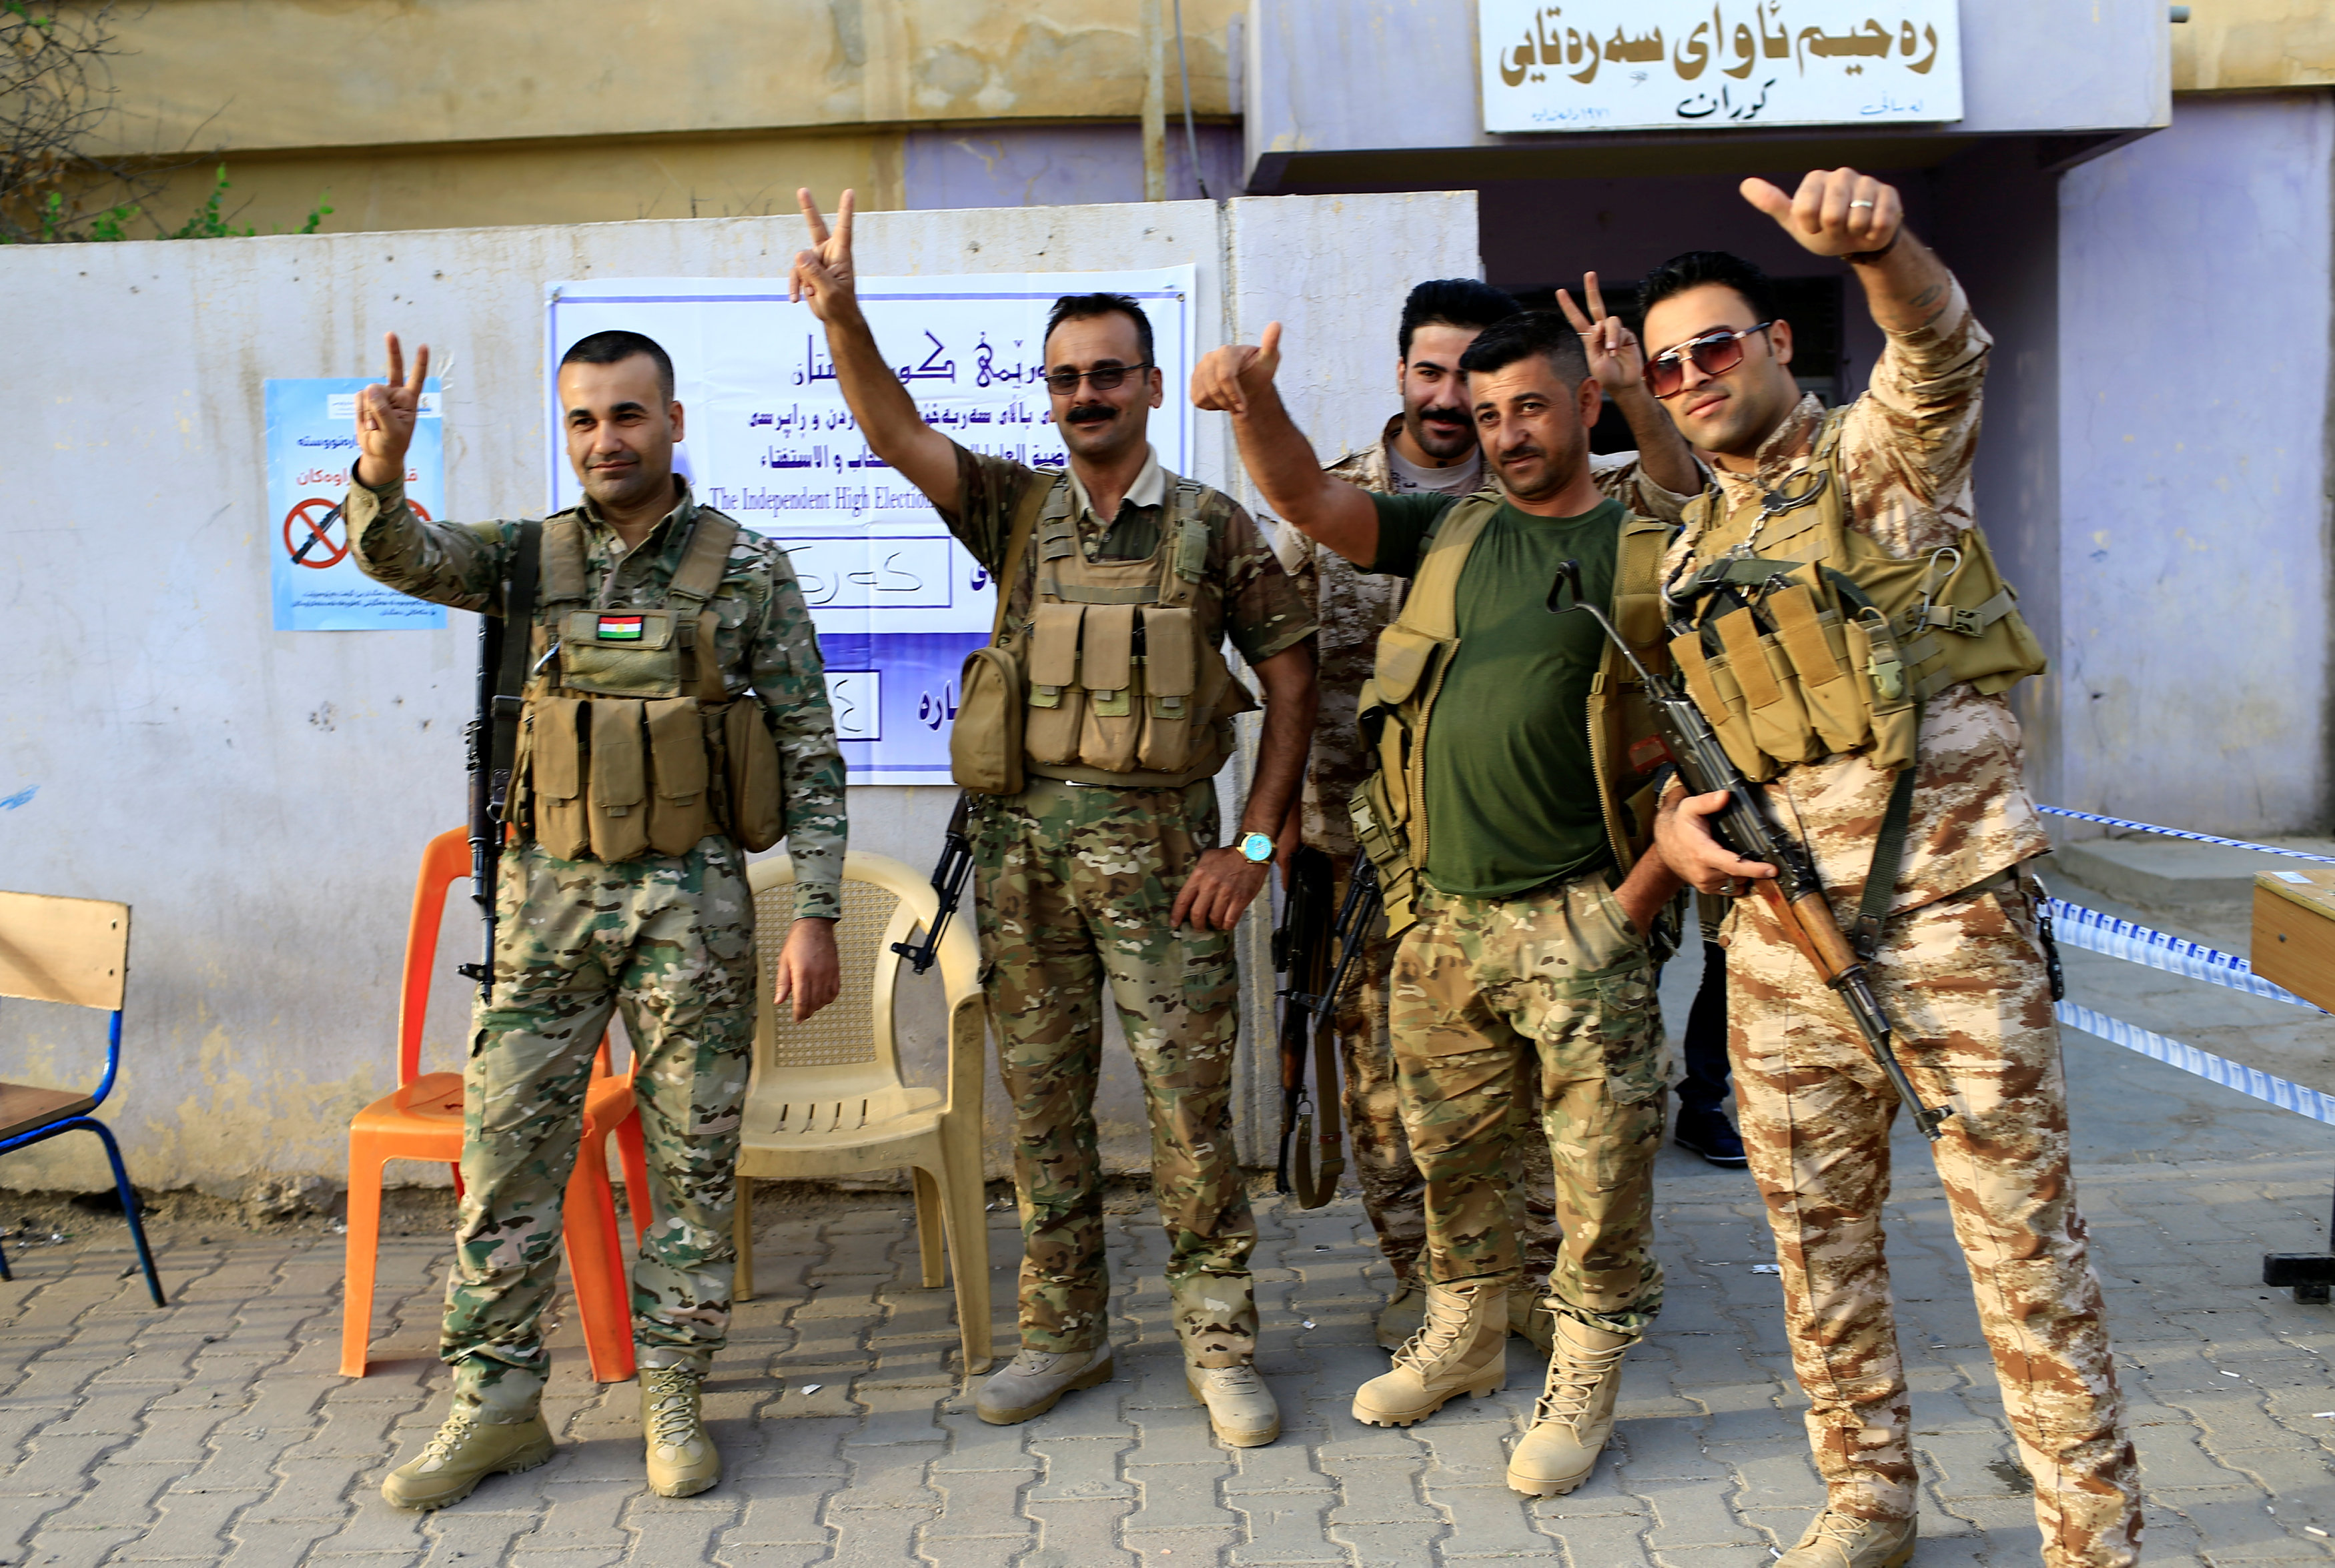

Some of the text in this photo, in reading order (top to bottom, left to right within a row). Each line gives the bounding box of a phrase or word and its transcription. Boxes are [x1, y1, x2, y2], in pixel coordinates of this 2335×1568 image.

[709, 487, 739, 510] The
[742, 486, 831, 518] Independent
[834, 486, 871, 517] High
